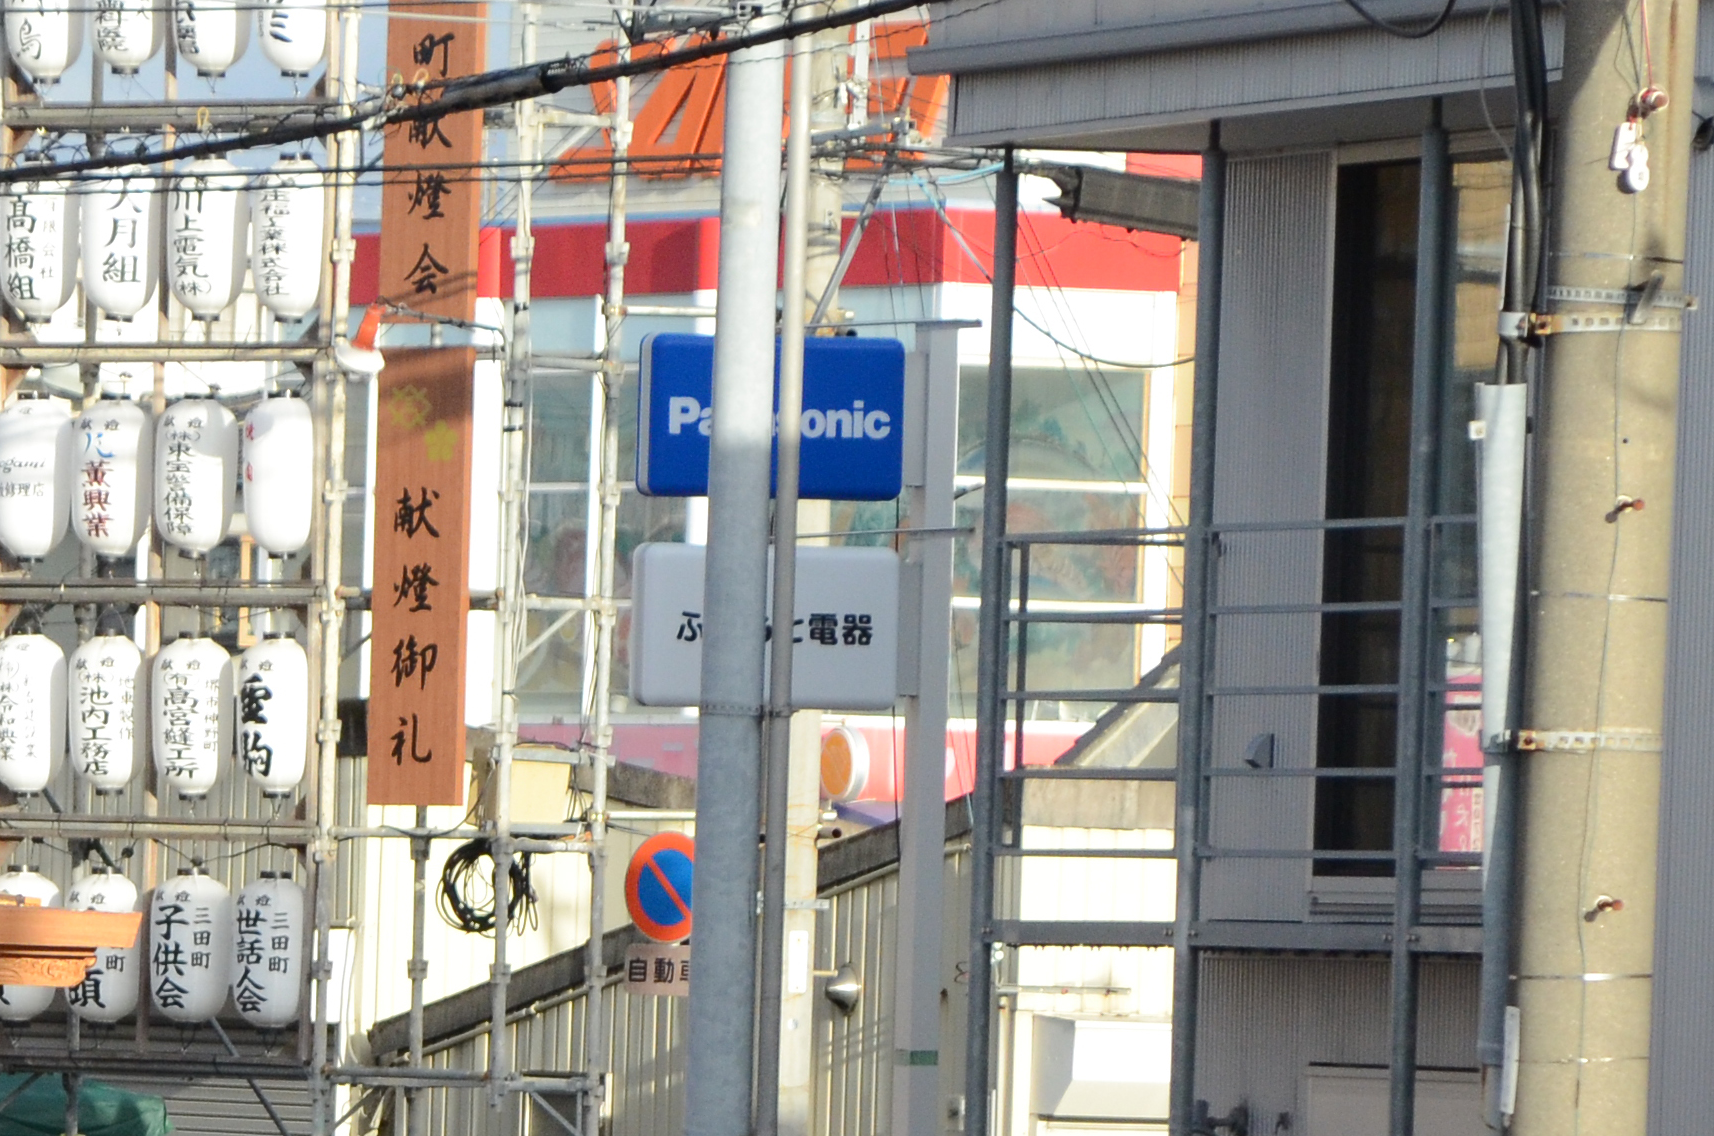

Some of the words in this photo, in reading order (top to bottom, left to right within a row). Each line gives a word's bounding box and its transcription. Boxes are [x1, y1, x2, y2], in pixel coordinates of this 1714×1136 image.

[390, 485, 441, 767] 献燈御礼
[151, 903, 190, 1010] 子供会
[190, 906, 213, 971] 三田町
[234, 907, 270, 1014] 世話人会
[267, 911, 291, 975] 三田町
